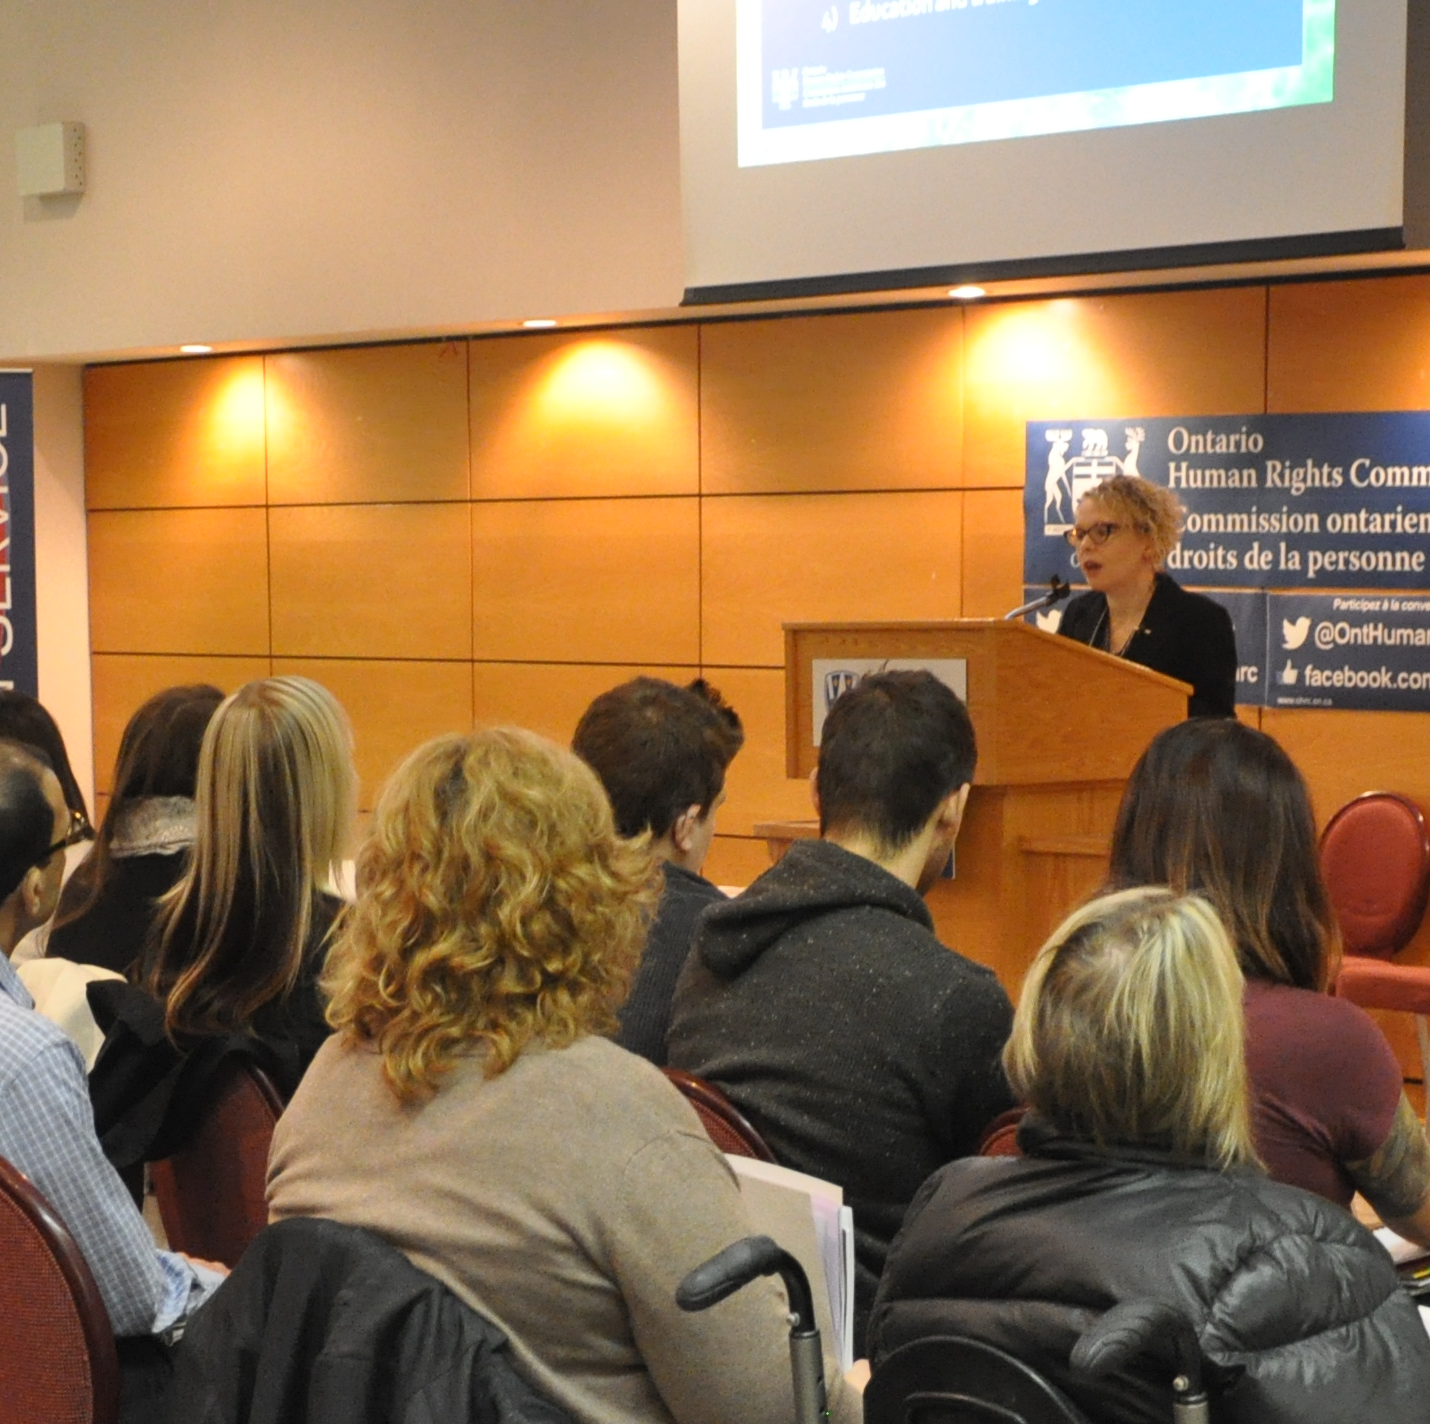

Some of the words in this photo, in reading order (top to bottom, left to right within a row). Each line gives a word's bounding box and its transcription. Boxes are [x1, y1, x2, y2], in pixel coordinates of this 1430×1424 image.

[1168, 426, 1263, 453] Ontario
[1168, 462, 1257, 488] Human
[1265, 460, 1342, 494] Rights
[1167, 543, 1238, 570] droits
[1245, 543, 1273, 570] de
[1279, 541, 1302, 568] la
[1307, 547, 1425, 577] personne
[1333, 598, 1379, 612] Participez
[1391, 598, 1400, 611] la
